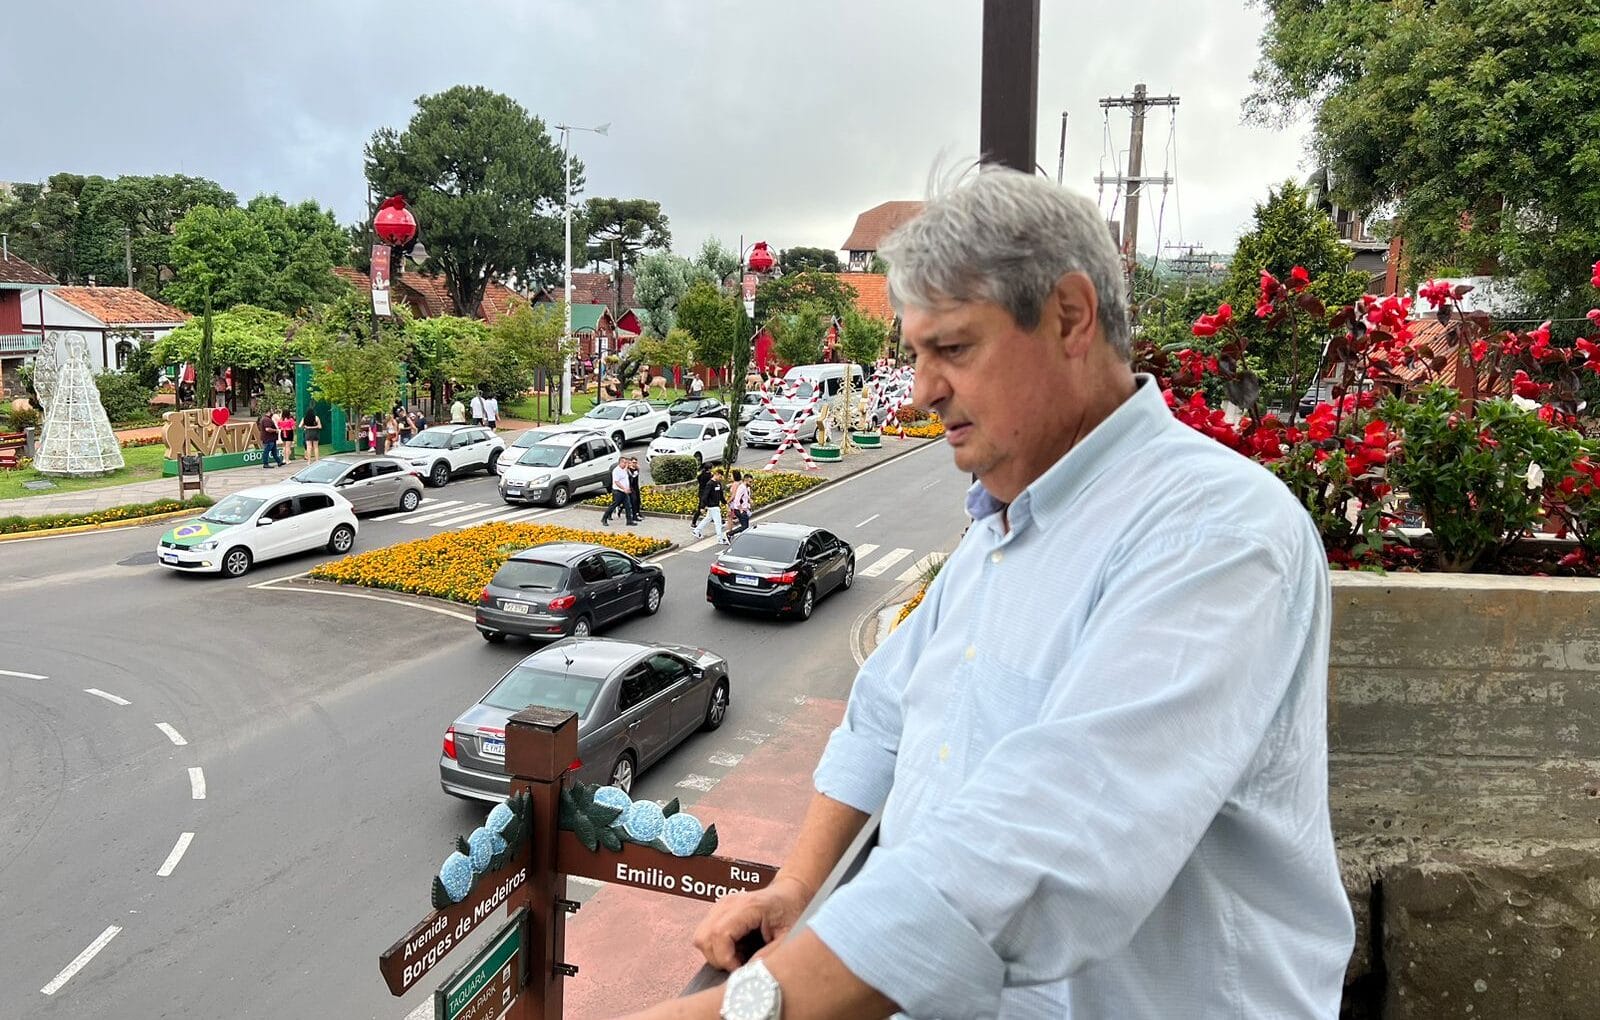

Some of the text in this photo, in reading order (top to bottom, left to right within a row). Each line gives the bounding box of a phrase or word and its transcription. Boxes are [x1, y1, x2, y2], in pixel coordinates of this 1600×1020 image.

[182, 409, 212, 428] EU
[616, 863, 676, 889] Emilio
[730, 866, 760, 884] Rua
[403, 867, 526, 988] Borges de Medeiros
[404, 915, 448, 960] Avenida
[449, 970, 486, 1013] TAQUARA
[477, 981, 497, 1010] PARK
